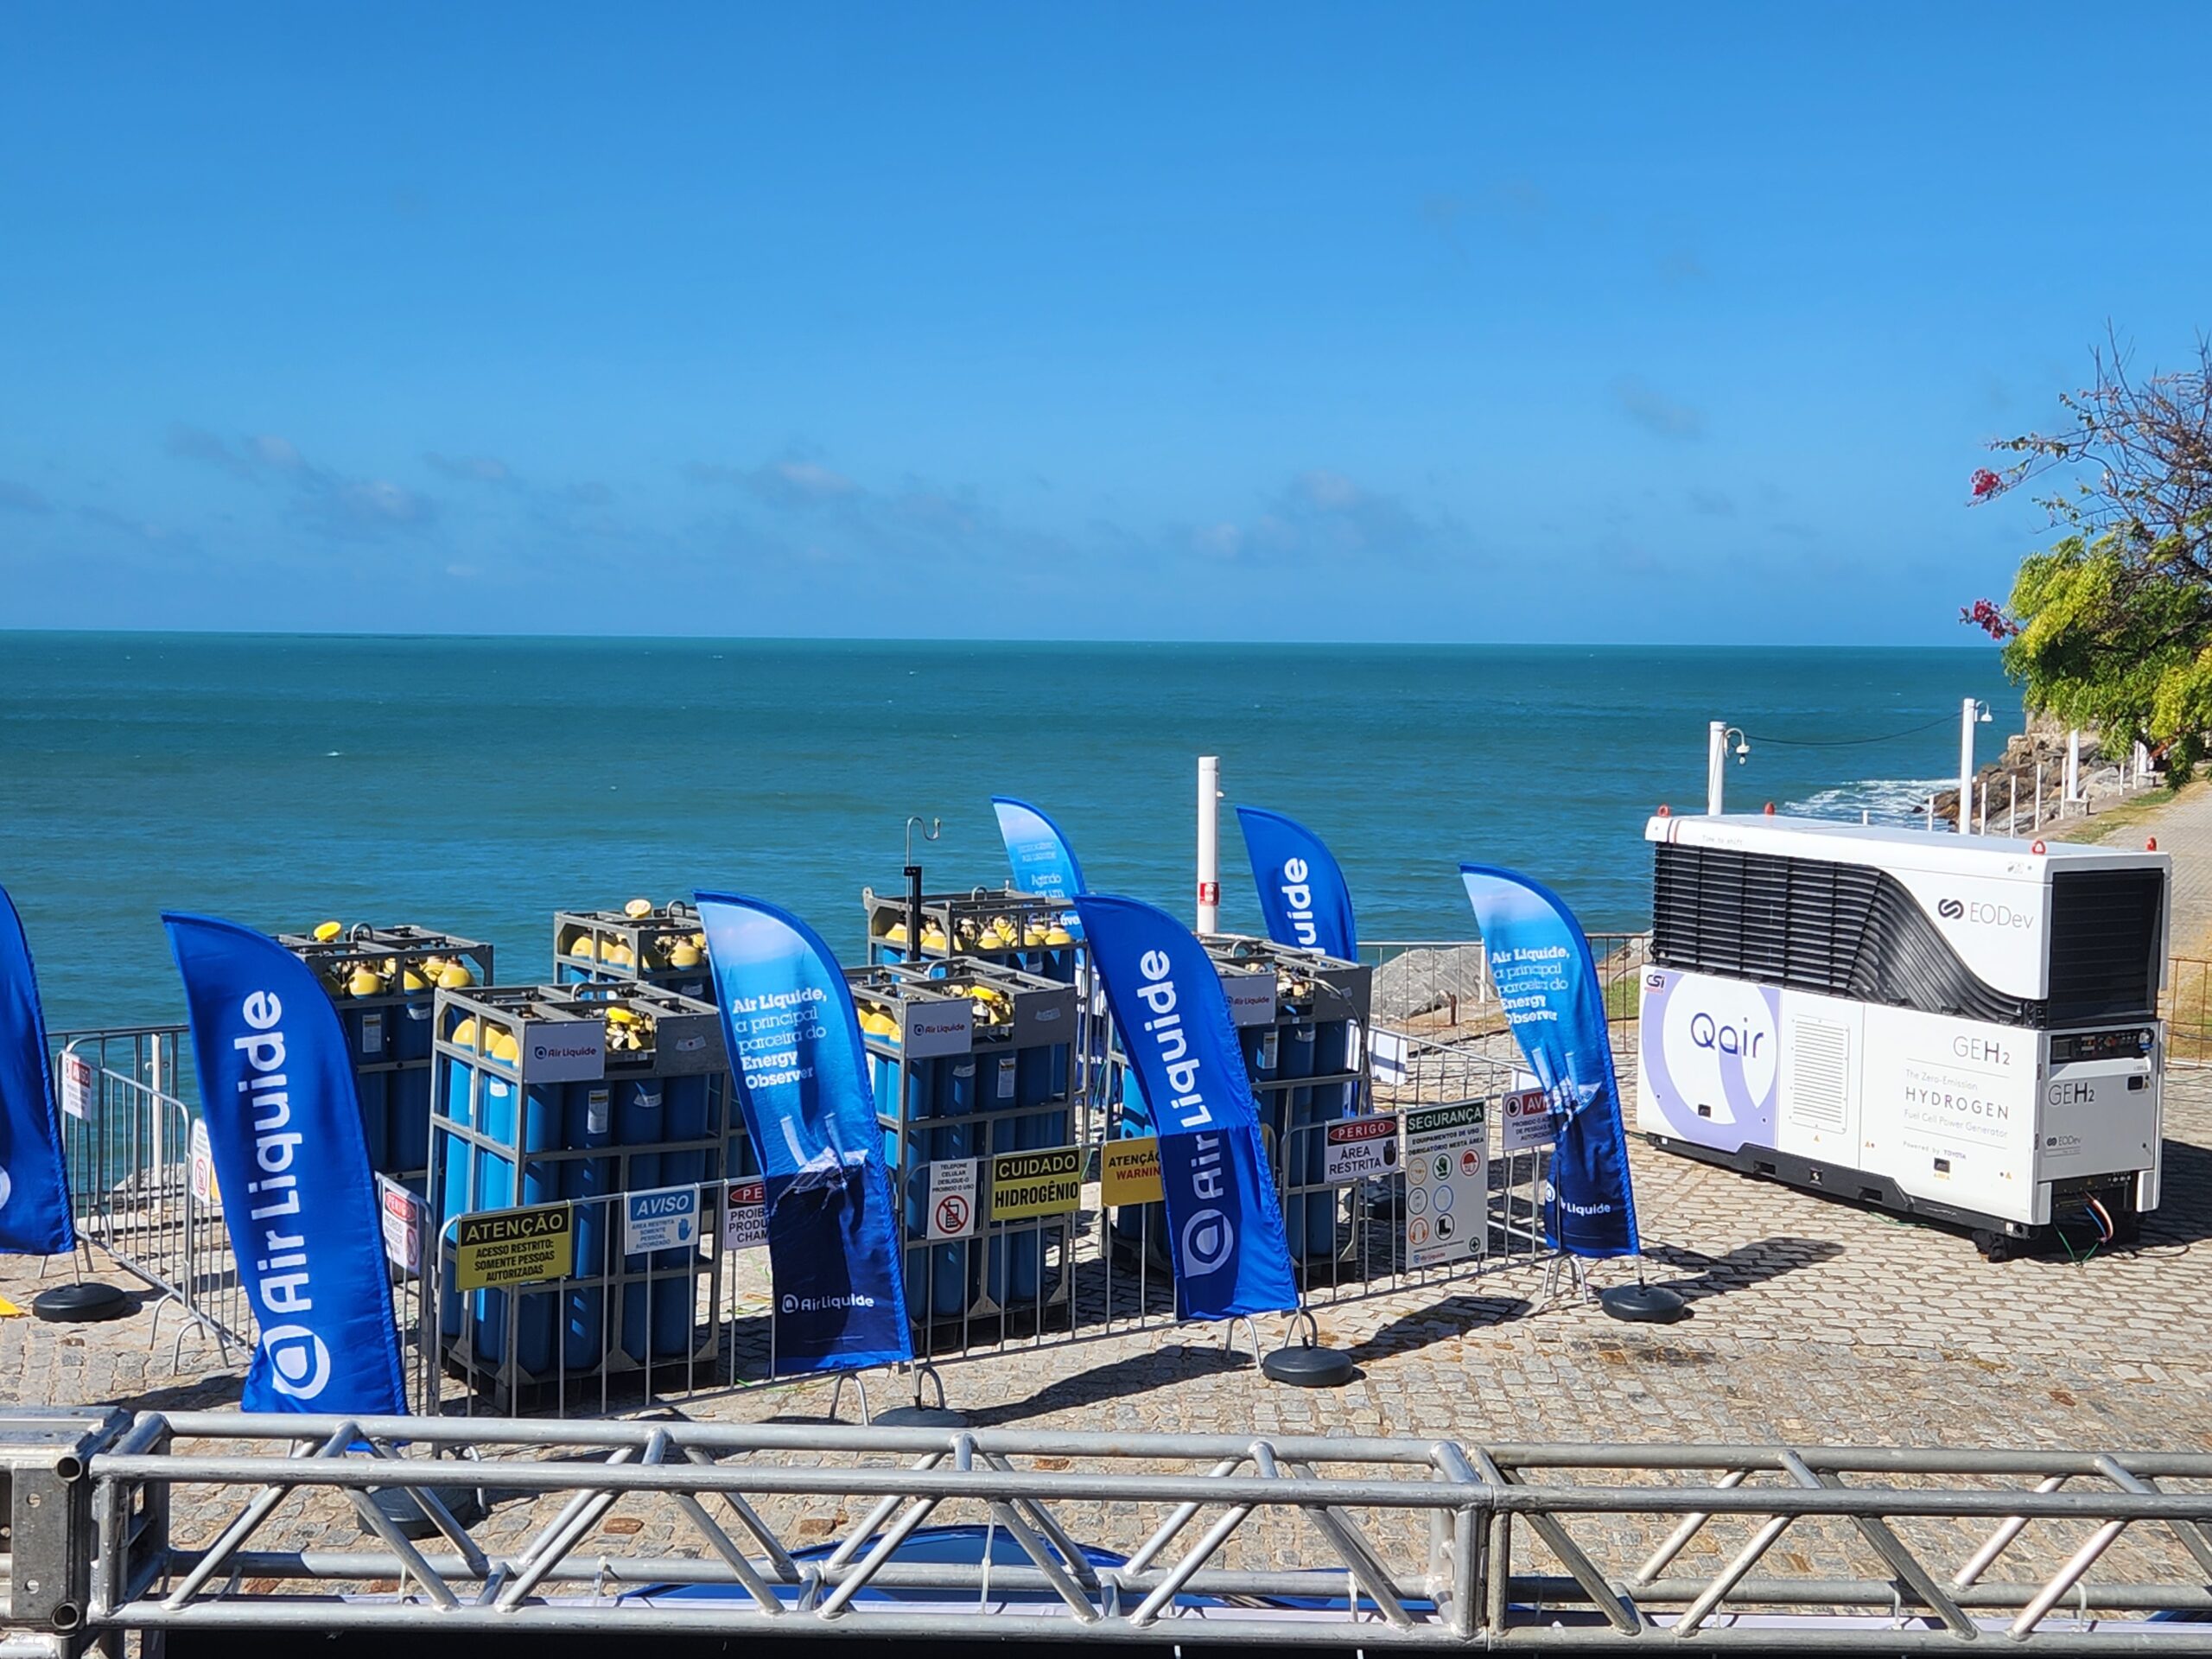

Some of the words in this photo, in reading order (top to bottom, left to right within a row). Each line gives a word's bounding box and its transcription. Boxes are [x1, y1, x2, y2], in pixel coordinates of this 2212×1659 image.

[1281, 857, 1325, 956] uide
[1970, 902, 2034, 929] EODev
[1491, 951, 1511, 963] Air
[1513, 945, 1570, 962] Liquide,
[1494, 969, 1504, 979] a
[1506, 962, 1561, 980] principal
[1549, 977, 1568, 990] do
[733, 998, 757, 1014] Air
[759, 988, 827, 1010] Liquide,
[1500, 995, 1547, 1010] Energy
[735, 1021, 747, 1033] a
[750, 1006, 818, 1034] principal
[925, 1026, 936, 1034] Air
[937, 1023, 965, 1033] Liquide
[738, 1031, 803, 1055] parceira
[806, 1026, 827, 1039] do
[1137, 950, 1212, 1128] Liquide
[1691, 1012, 1764, 1058] Qair
[548, 1049, 562, 1058] Air
[563, 1046, 597, 1058] Liquide
[741, 1051, 798, 1071] Energy
[745, 1066, 813, 1090] Observer
[1906, 1069, 1919, 1078] The
[1922, 1071, 1978, 1090] Zero-Emission
[234, 990, 302, 1220] Liquide
[1905, 1086, 2009, 1121] HYDROGEN
[1408, 1106, 1482, 1131] SEGURANÇA
[1904, 1109, 1920, 1120] Fuel
[1922, 1113, 1937, 1122] Cell
[1939, 1116, 1964, 1128] Power
[1966, 1122, 2008, 1138] Generator
[1338, 1123, 1386, 1140] PERIGO
[1412, 1132, 1457, 1145] EQUIPAMENTOS
[1340, 1146, 1371, 1160] ÁREA
[999, 1154, 1076, 1178] CUIDADO
[1116, 1166, 1161, 1180] WARNIN
[1191, 1134, 1224, 1200] Air
[1329, 1157, 1382, 1174] RESTRITA
[995, 1180, 1078, 1208] HIDROGÊNIO
[636, 1194, 689, 1217] AVISO
[730, 1207, 766, 1222] PROIB
[1567, 1202, 1611, 1217] Liquide
[466, 1213, 563, 1242] ATENÇÃO
[729, 1219, 768, 1233] PRODU
[476, 1243, 509, 1258] ACESSO
[511, 1239, 553, 1254] RESTRITO:
[474, 1255, 516, 1271] SOMENTE
[518, 1250, 555, 1265] PESSOAS
[257, 1230, 312, 1313] Air
[486, 1264, 544, 1281] AUTORIZADAS
[801, 1298, 820, 1311] Air
[822, 1293, 874, 1310] Liquide
